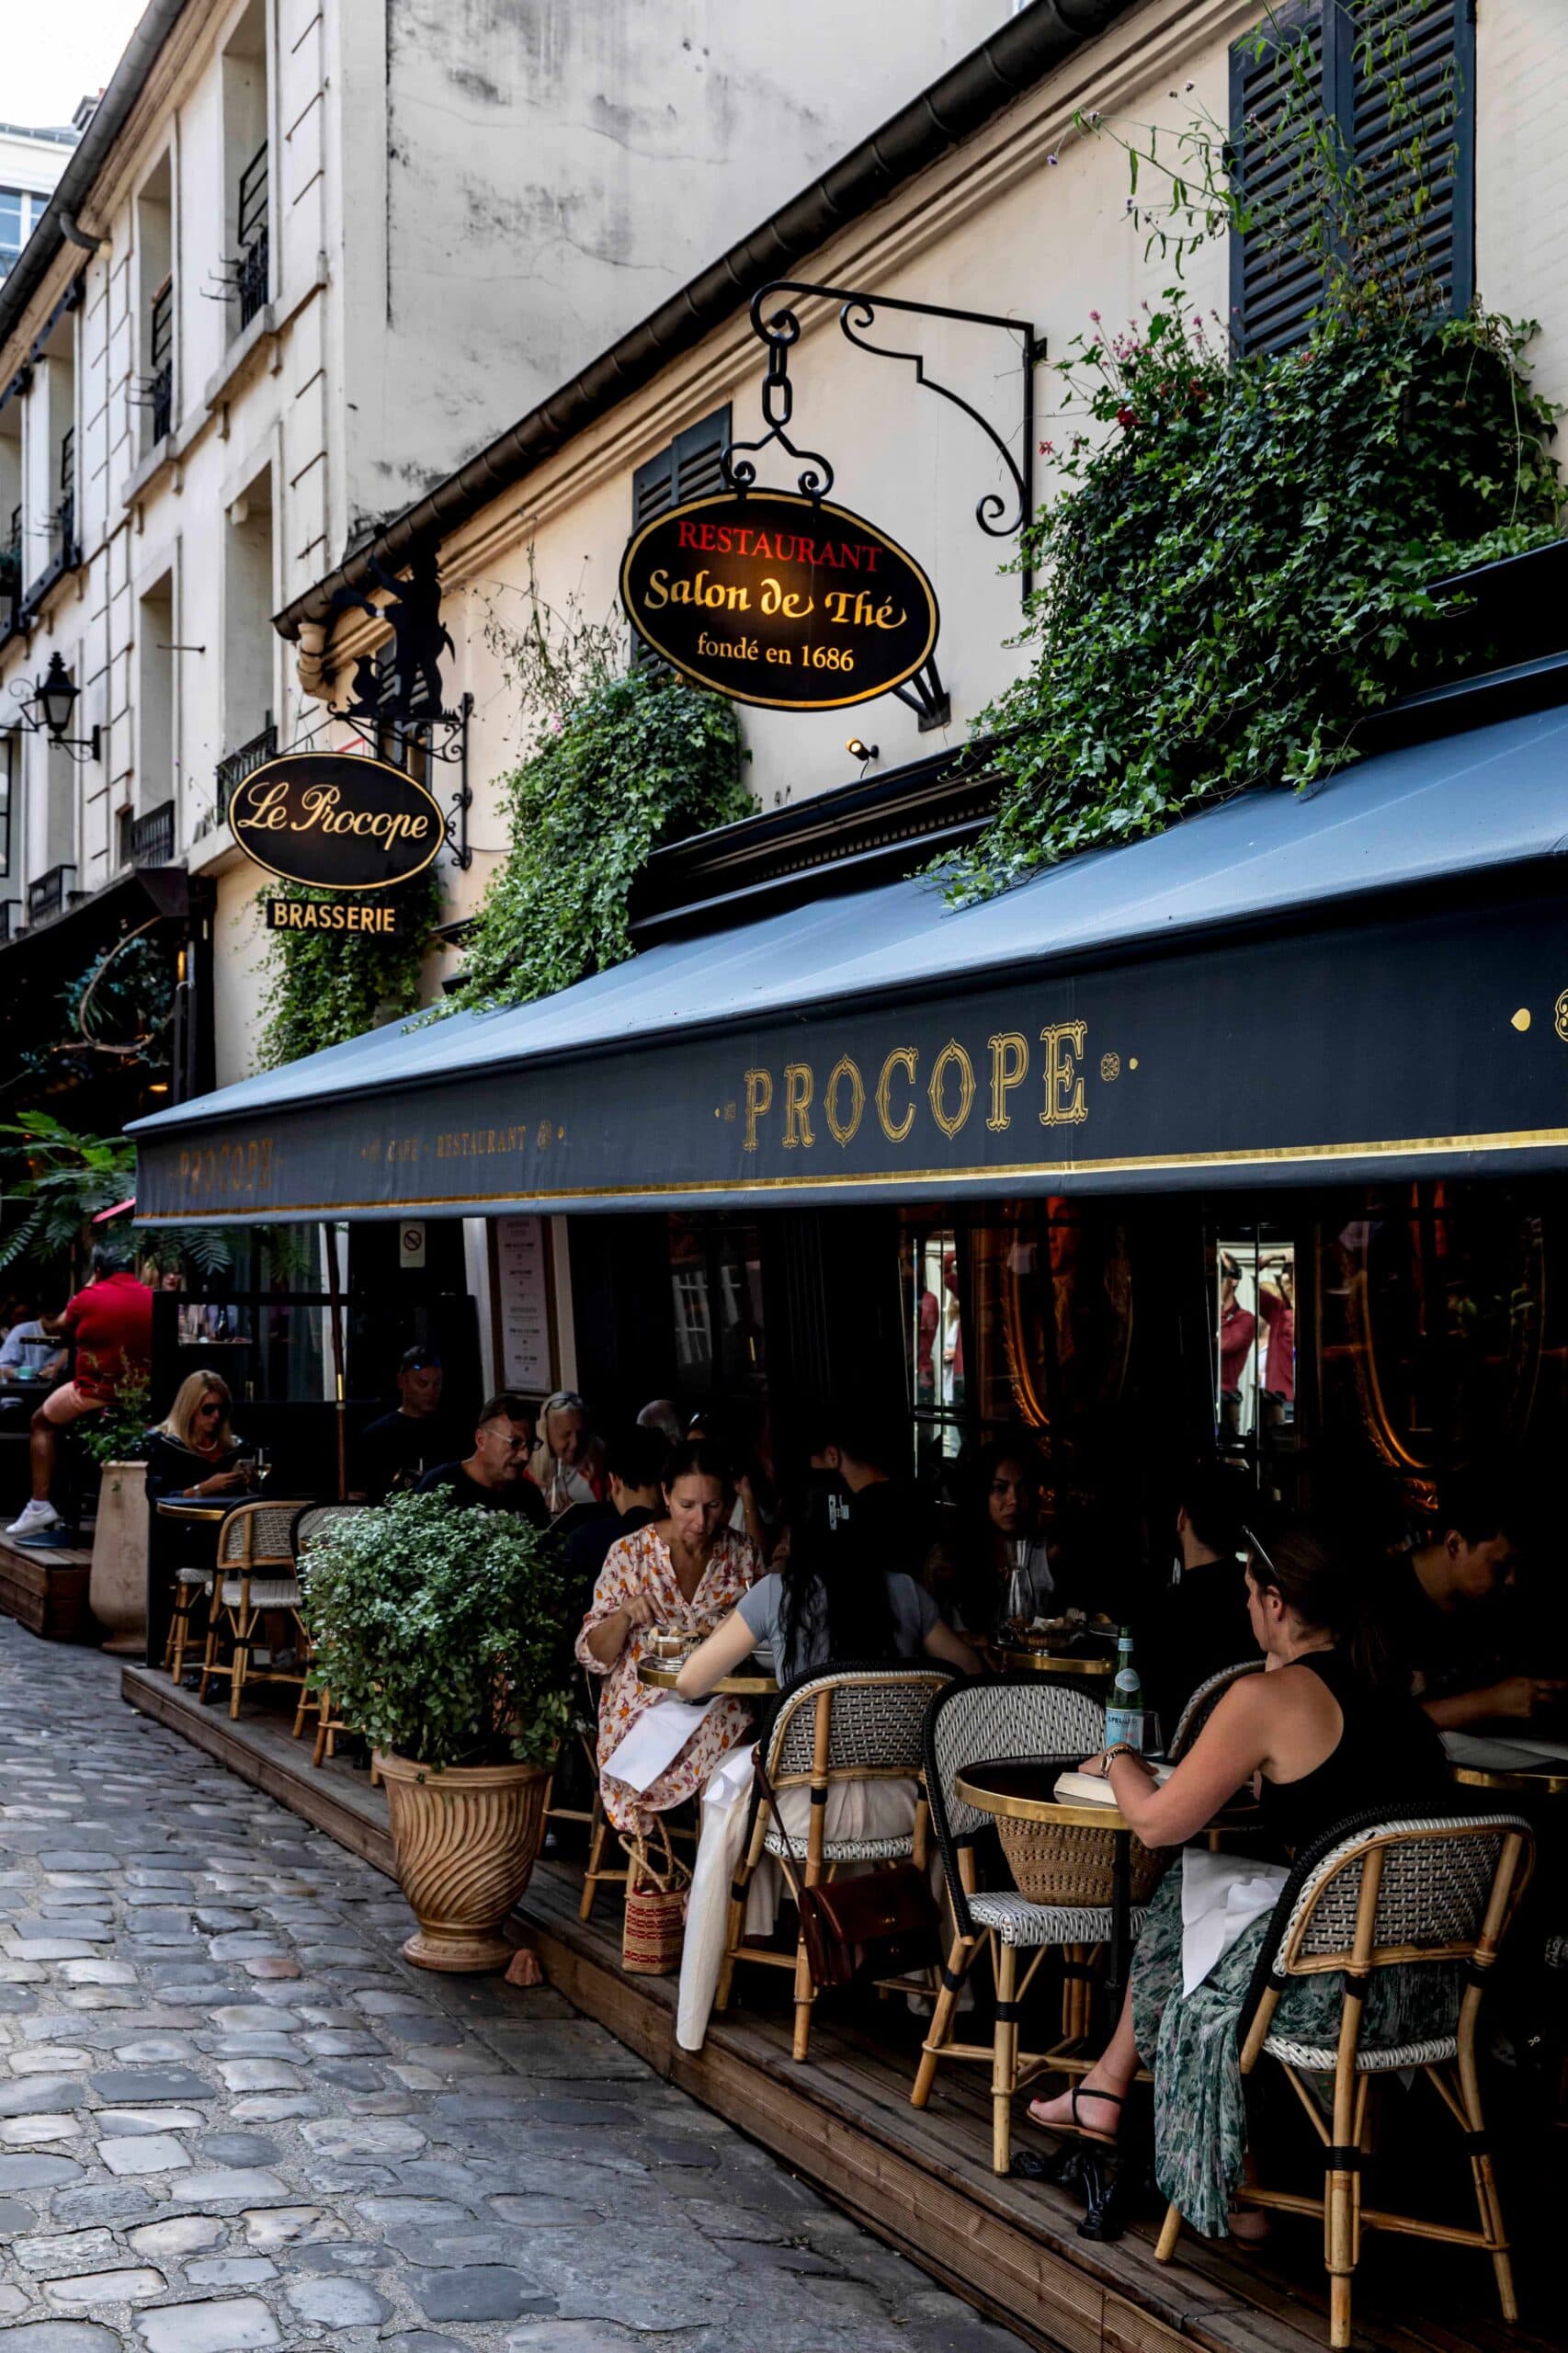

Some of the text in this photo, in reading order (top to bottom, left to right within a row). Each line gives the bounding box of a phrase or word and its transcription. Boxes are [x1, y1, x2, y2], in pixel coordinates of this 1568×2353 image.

[678, 520, 883, 573] RESTAURANT
[644, 569, 908, 629] Salon de Thé
[697, 631, 854, 672] fondé en 1686
[237, 782, 428, 851] Le Procope
[275, 903, 395, 934] BRASSERIE
[742, 1018, 1089, 1153] PROCOPE
[179, 1138, 273, 1194] PROCOPE
[437, 1126, 527, 1159] RESTAURANT
